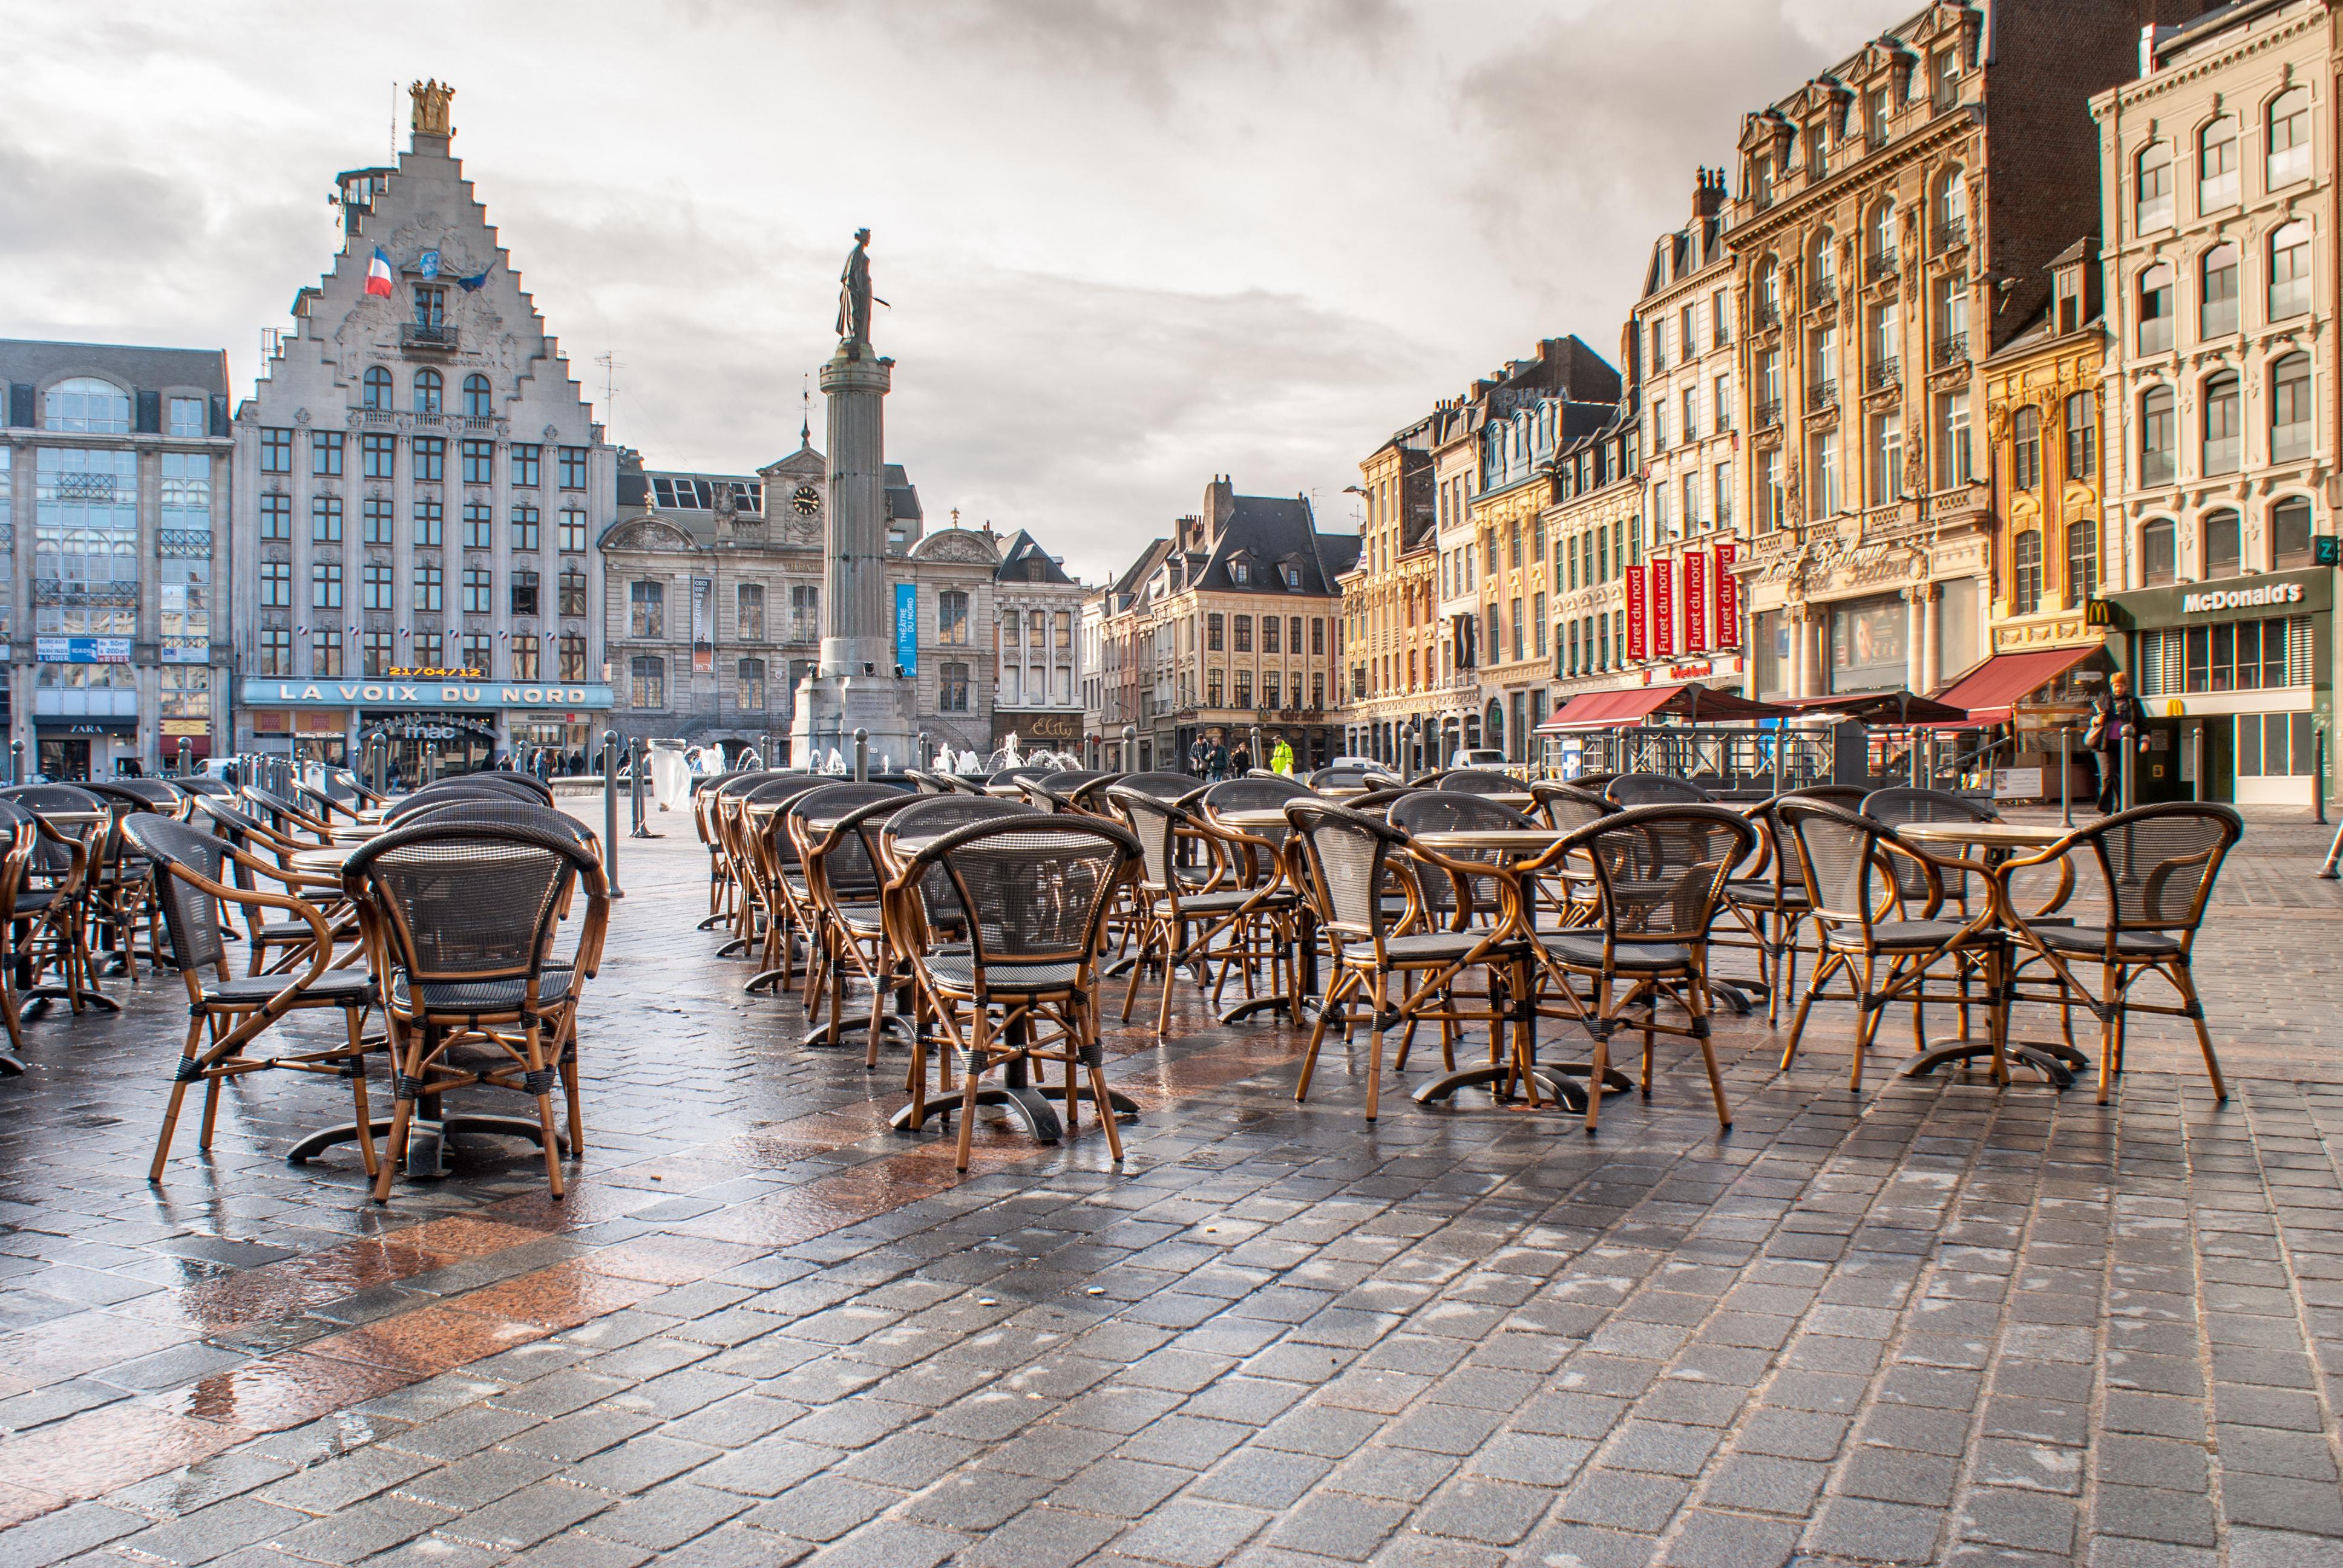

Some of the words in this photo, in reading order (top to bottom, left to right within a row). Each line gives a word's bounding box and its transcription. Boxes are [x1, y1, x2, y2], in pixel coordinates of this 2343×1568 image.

[784, 562, 822, 572] THEATR
[1656, 563, 1668, 593] nord
[1689, 557, 1700, 588] nord
[1630, 570, 1641, 599] nord
[1720, 585, 1731, 604] du
[1657, 597, 1668, 614] du
[1689, 591, 1700, 609] du
[2183, 583, 2304, 613] McDonald's
[1631, 603, 1642, 619] du
[898, 608, 907, 643] THÉÂTRE
[908, 622, 914, 633] DU
[1658, 616, 1669, 652] Furet
[1690, 612, 1701, 647] Furet
[1721, 606, 1732, 643] Furet
[1631, 622, 1642, 655] Furet
[388, 667, 481, 676] 21/04/12
[280, 685, 323, 700] LA
[338, 685, 419, 701] VOIX
[442, 687, 481, 702] DU
[502, 688, 586, 704] NORD
[440, 712, 487, 734] PLACE
